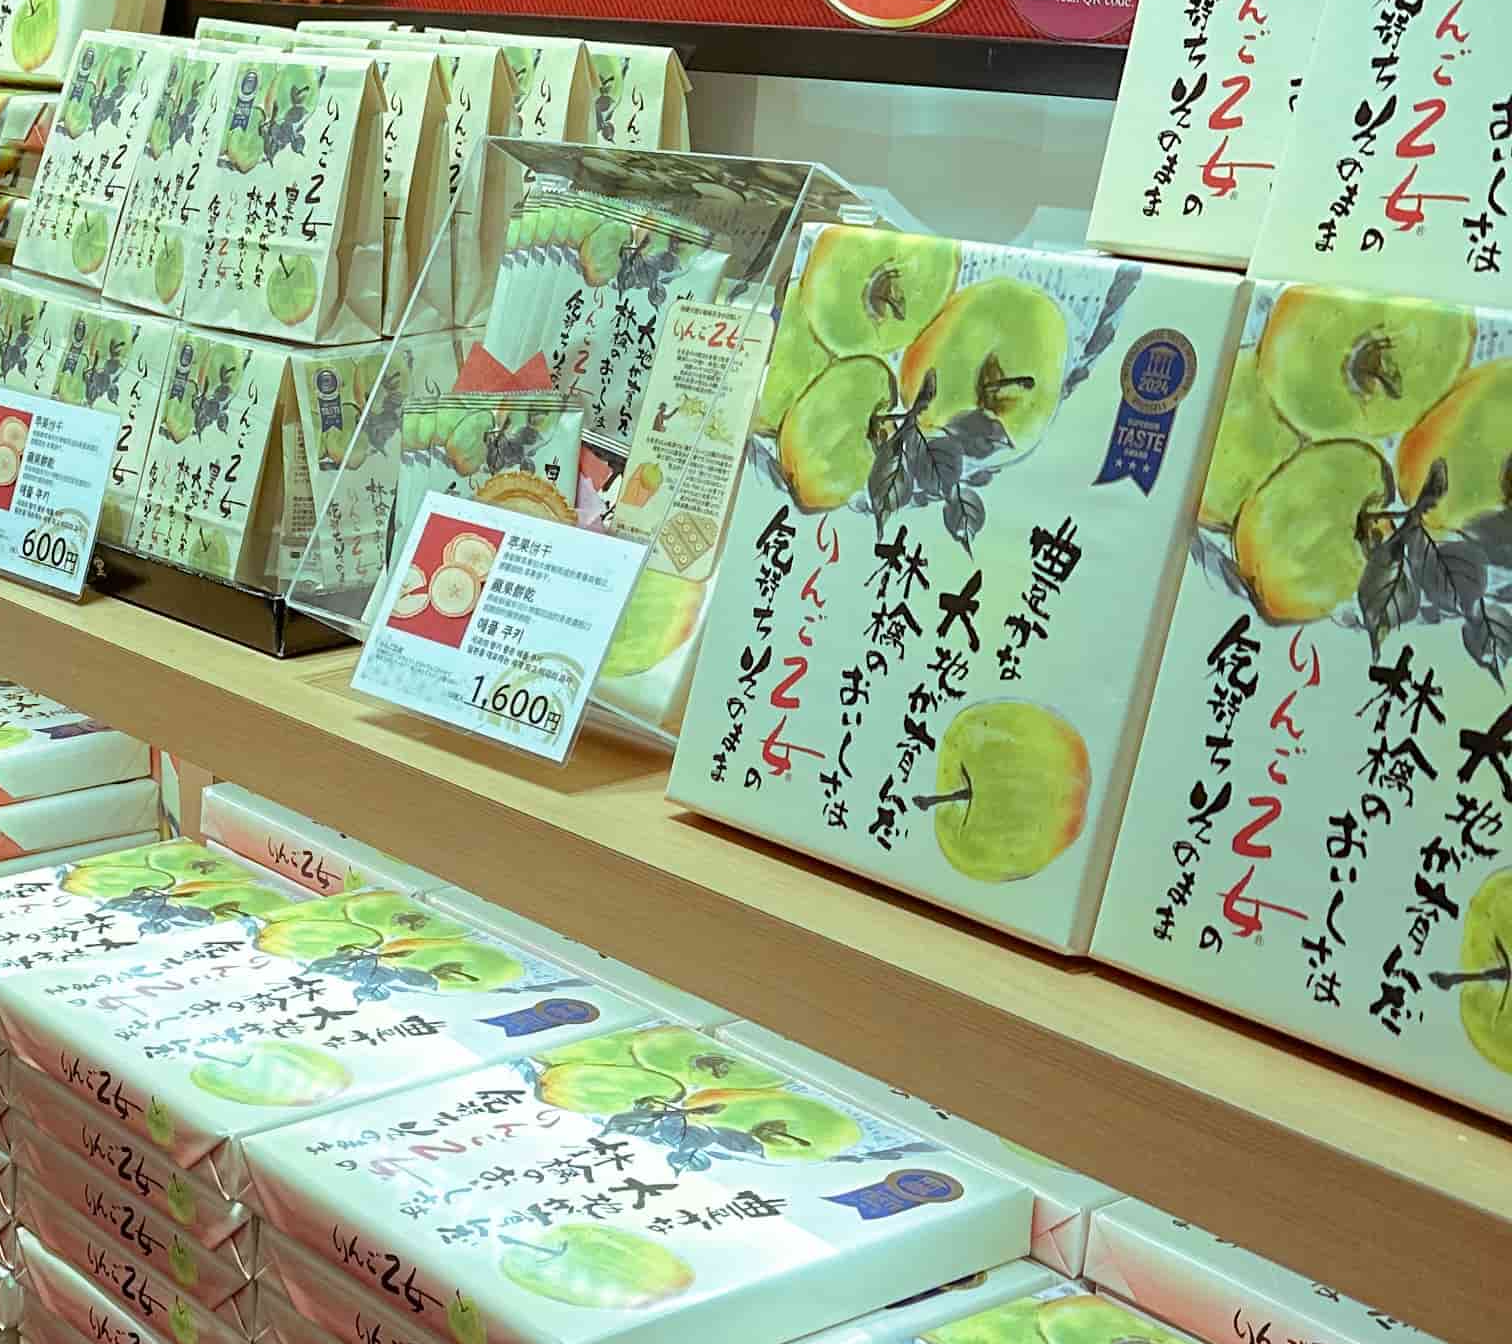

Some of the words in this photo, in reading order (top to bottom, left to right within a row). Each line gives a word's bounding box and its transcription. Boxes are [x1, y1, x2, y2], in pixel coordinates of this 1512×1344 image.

[1138, 376, 1169, 395] 2024
[1118, 425, 1166, 453] TASTE
[22, 528, 79, 572] 600円
[476, 617, 499, 638] 애플
[502, 625, 525, 645] 쿠키
[471, 675, 562, 732] 1,600円
